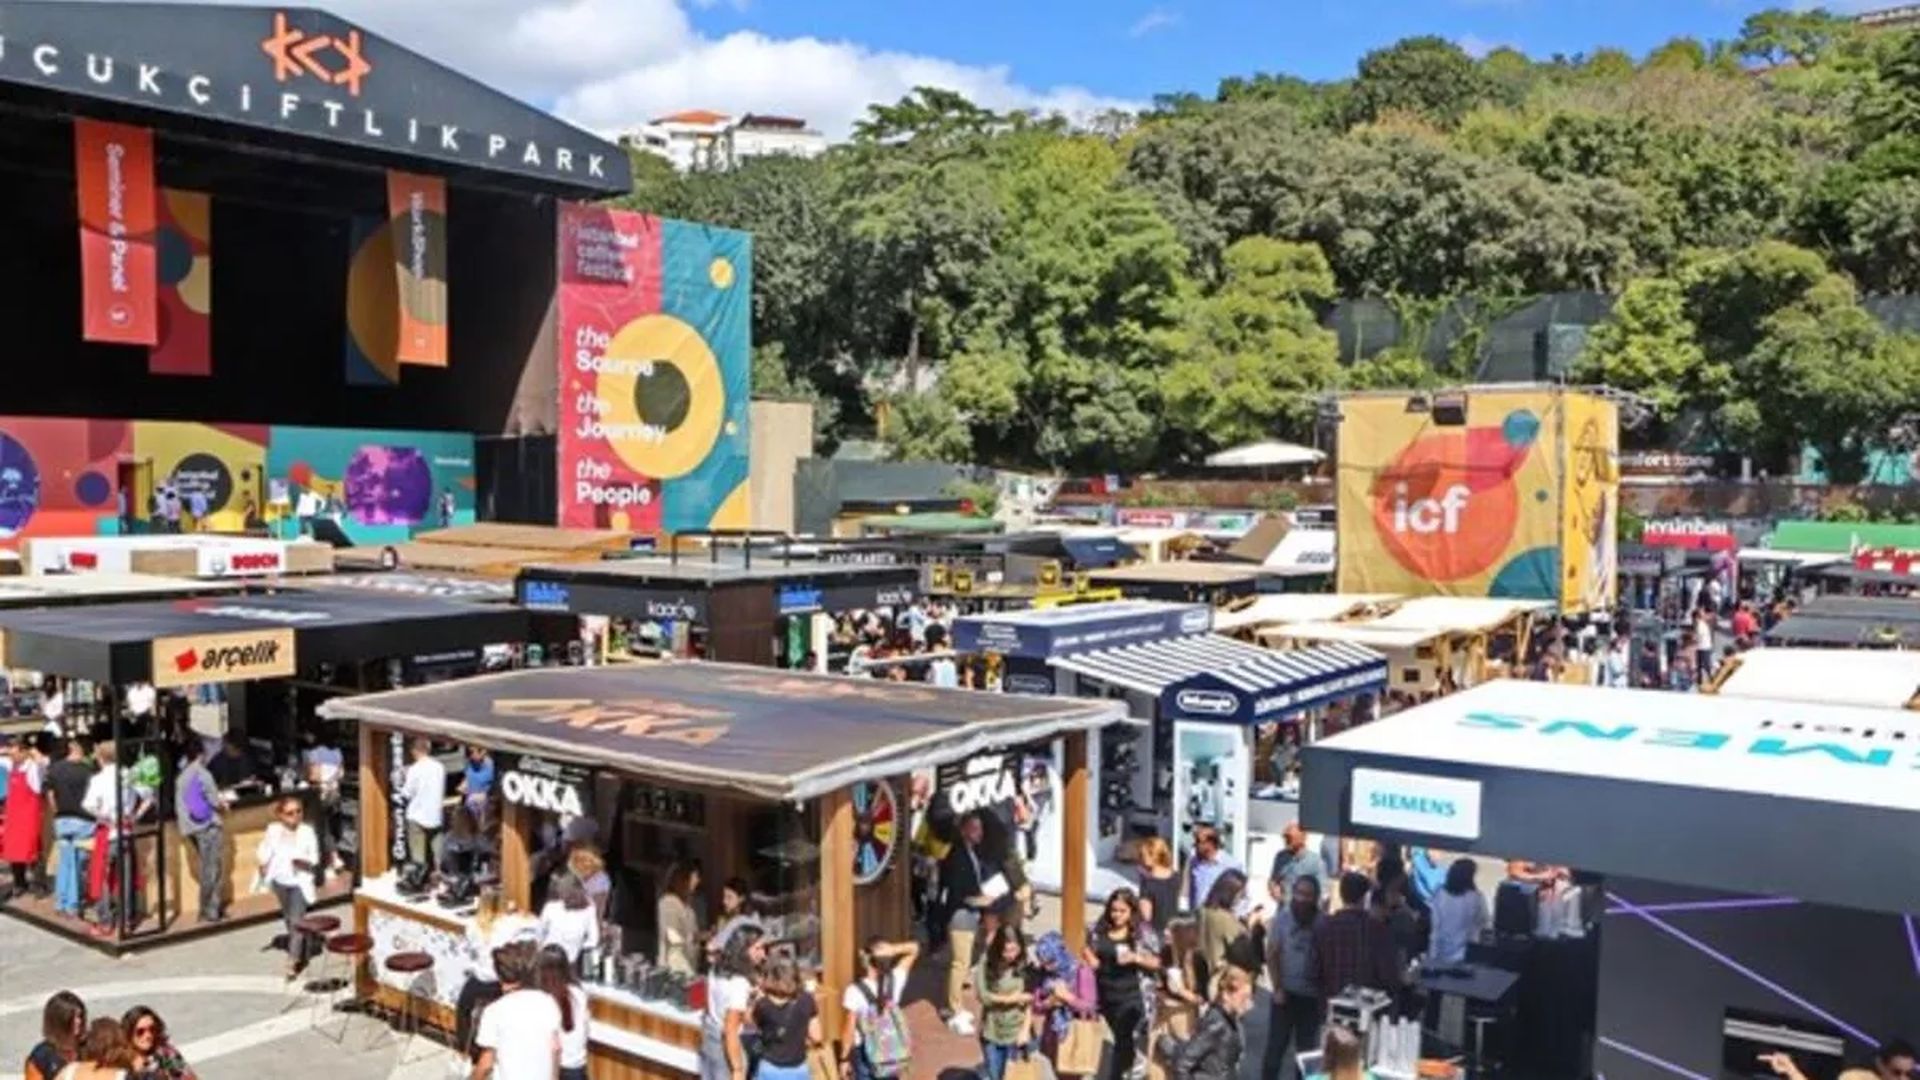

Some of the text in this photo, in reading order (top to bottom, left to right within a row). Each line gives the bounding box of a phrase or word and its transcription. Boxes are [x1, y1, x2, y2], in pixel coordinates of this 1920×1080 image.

[488, 134, 604, 178] PARK
[110, 240, 128, 292] Panel
[576, 325, 610, 348] the
[576, 348, 654, 378] Source
[576, 390, 611, 415] the
[576, 416, 667, 444] Journey
[576, 457, 612, 480] the
[576, 480, 651, 508] People
[1394, 481, 1472, 534] icf
[201, 638, 281, 673] arçelik
[1455, 712, 1920, 769] MENS
[502, 771, 583, 817] OKKA
[949, 768, 1017, 814] OKKA
[1369, 791, 1457, 818] SIEMENS
